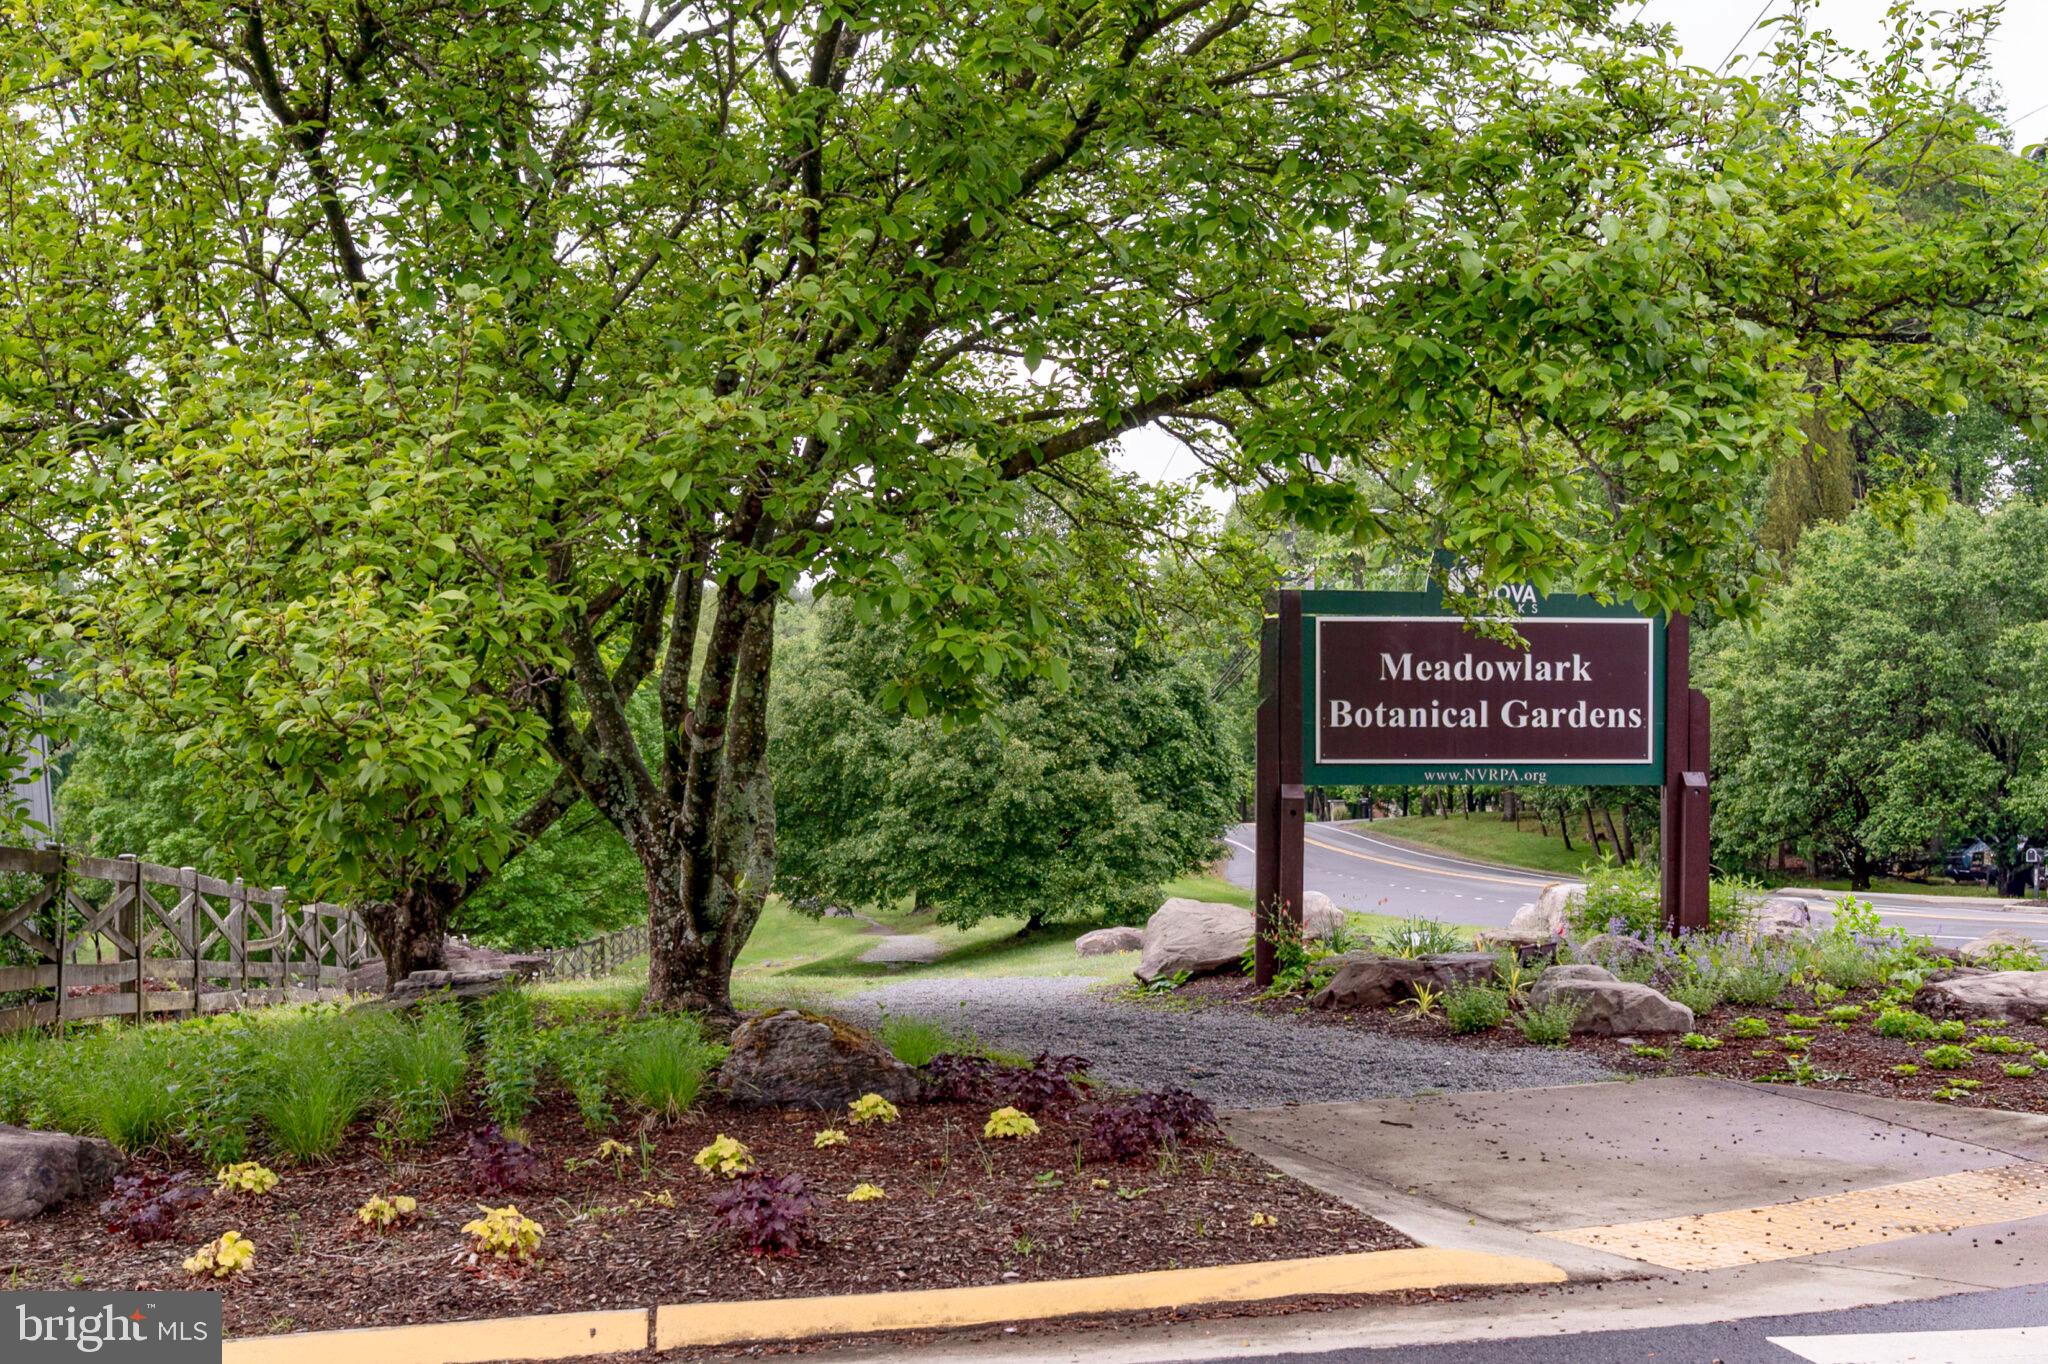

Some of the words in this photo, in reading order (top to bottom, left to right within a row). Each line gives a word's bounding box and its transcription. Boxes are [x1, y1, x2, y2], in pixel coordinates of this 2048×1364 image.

[1380, 653, 1592, 682] Meadowlark
[1329, 699, 1488, 729] Botanical
[1500, 699, 1642, 729] Gardens
[1424, 768, 1548, 784] www.NVRPA.org
